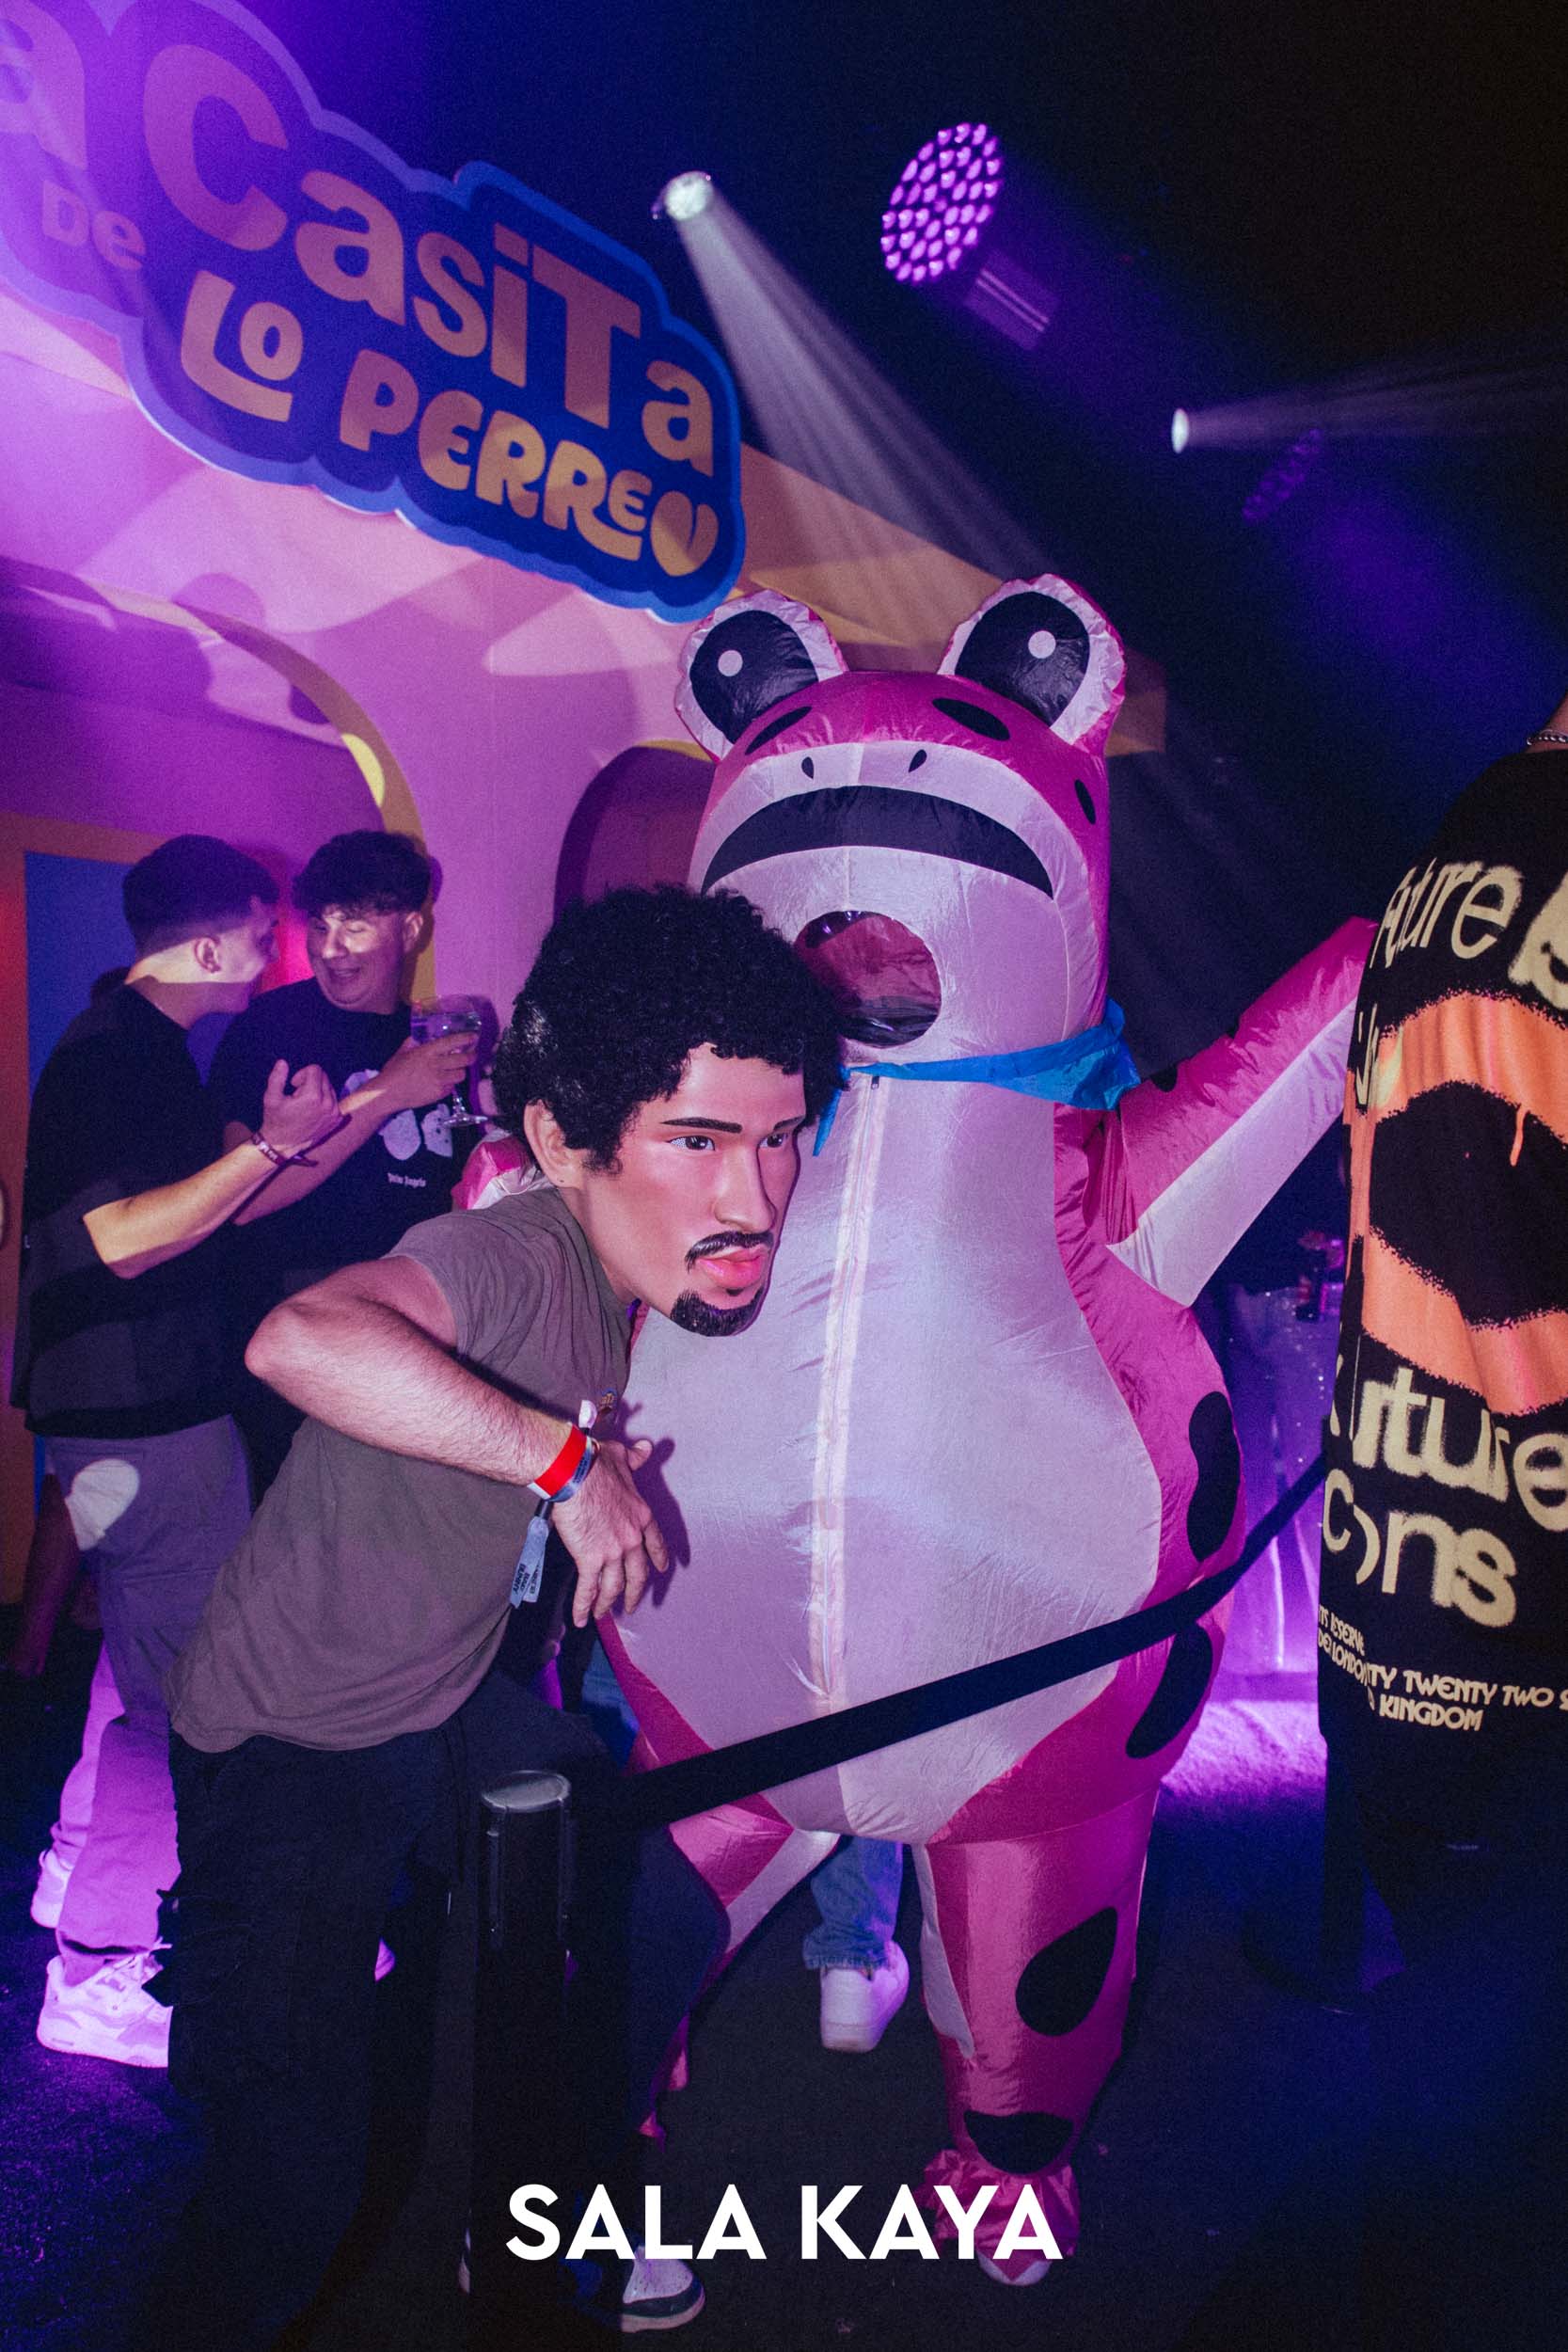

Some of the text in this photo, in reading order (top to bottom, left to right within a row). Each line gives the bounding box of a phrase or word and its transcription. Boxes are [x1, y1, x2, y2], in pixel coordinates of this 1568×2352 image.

[1402, 1669, 1497, 1706] TWENTY
[1502, 1685, 1554, 1708] TWO
[1379, 1693, 1484, 1732] KINGDOM
